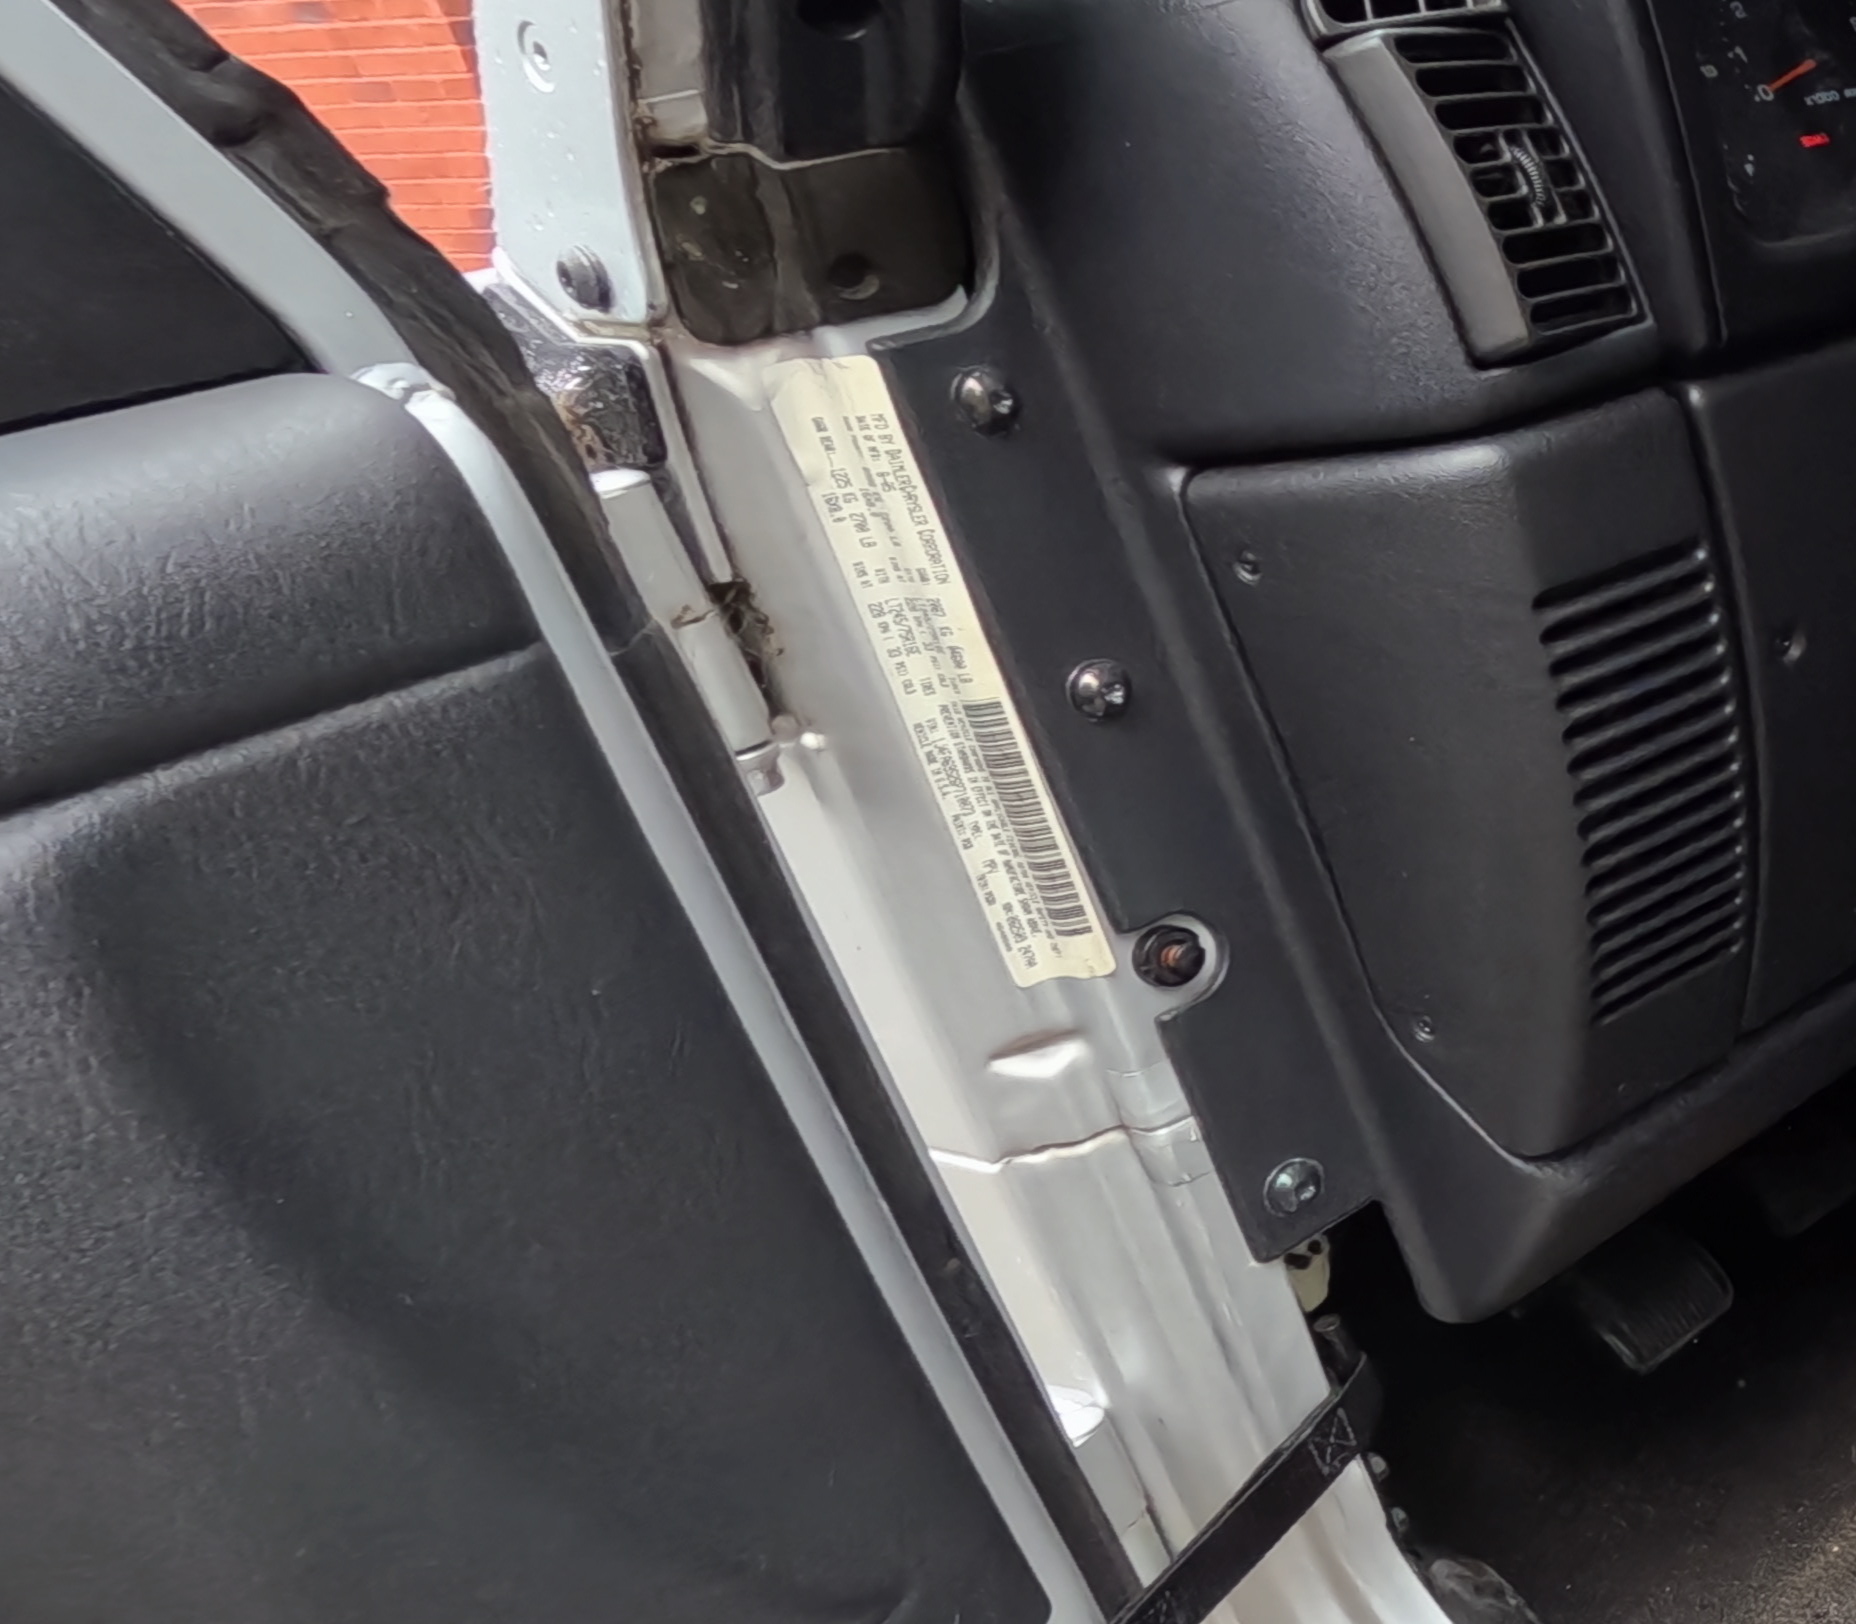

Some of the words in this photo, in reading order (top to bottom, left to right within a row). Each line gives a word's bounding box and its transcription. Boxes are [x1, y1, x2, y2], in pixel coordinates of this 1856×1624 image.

[1729, 1, 1748, 19] 2
[1735, 46, 1748, 63] 1
[1757, 84, 1774, 101] 0
[877, 433, 896, 446] BY
[857, 535, 877, 549] LB
[956, 672, 973, 684] LB
